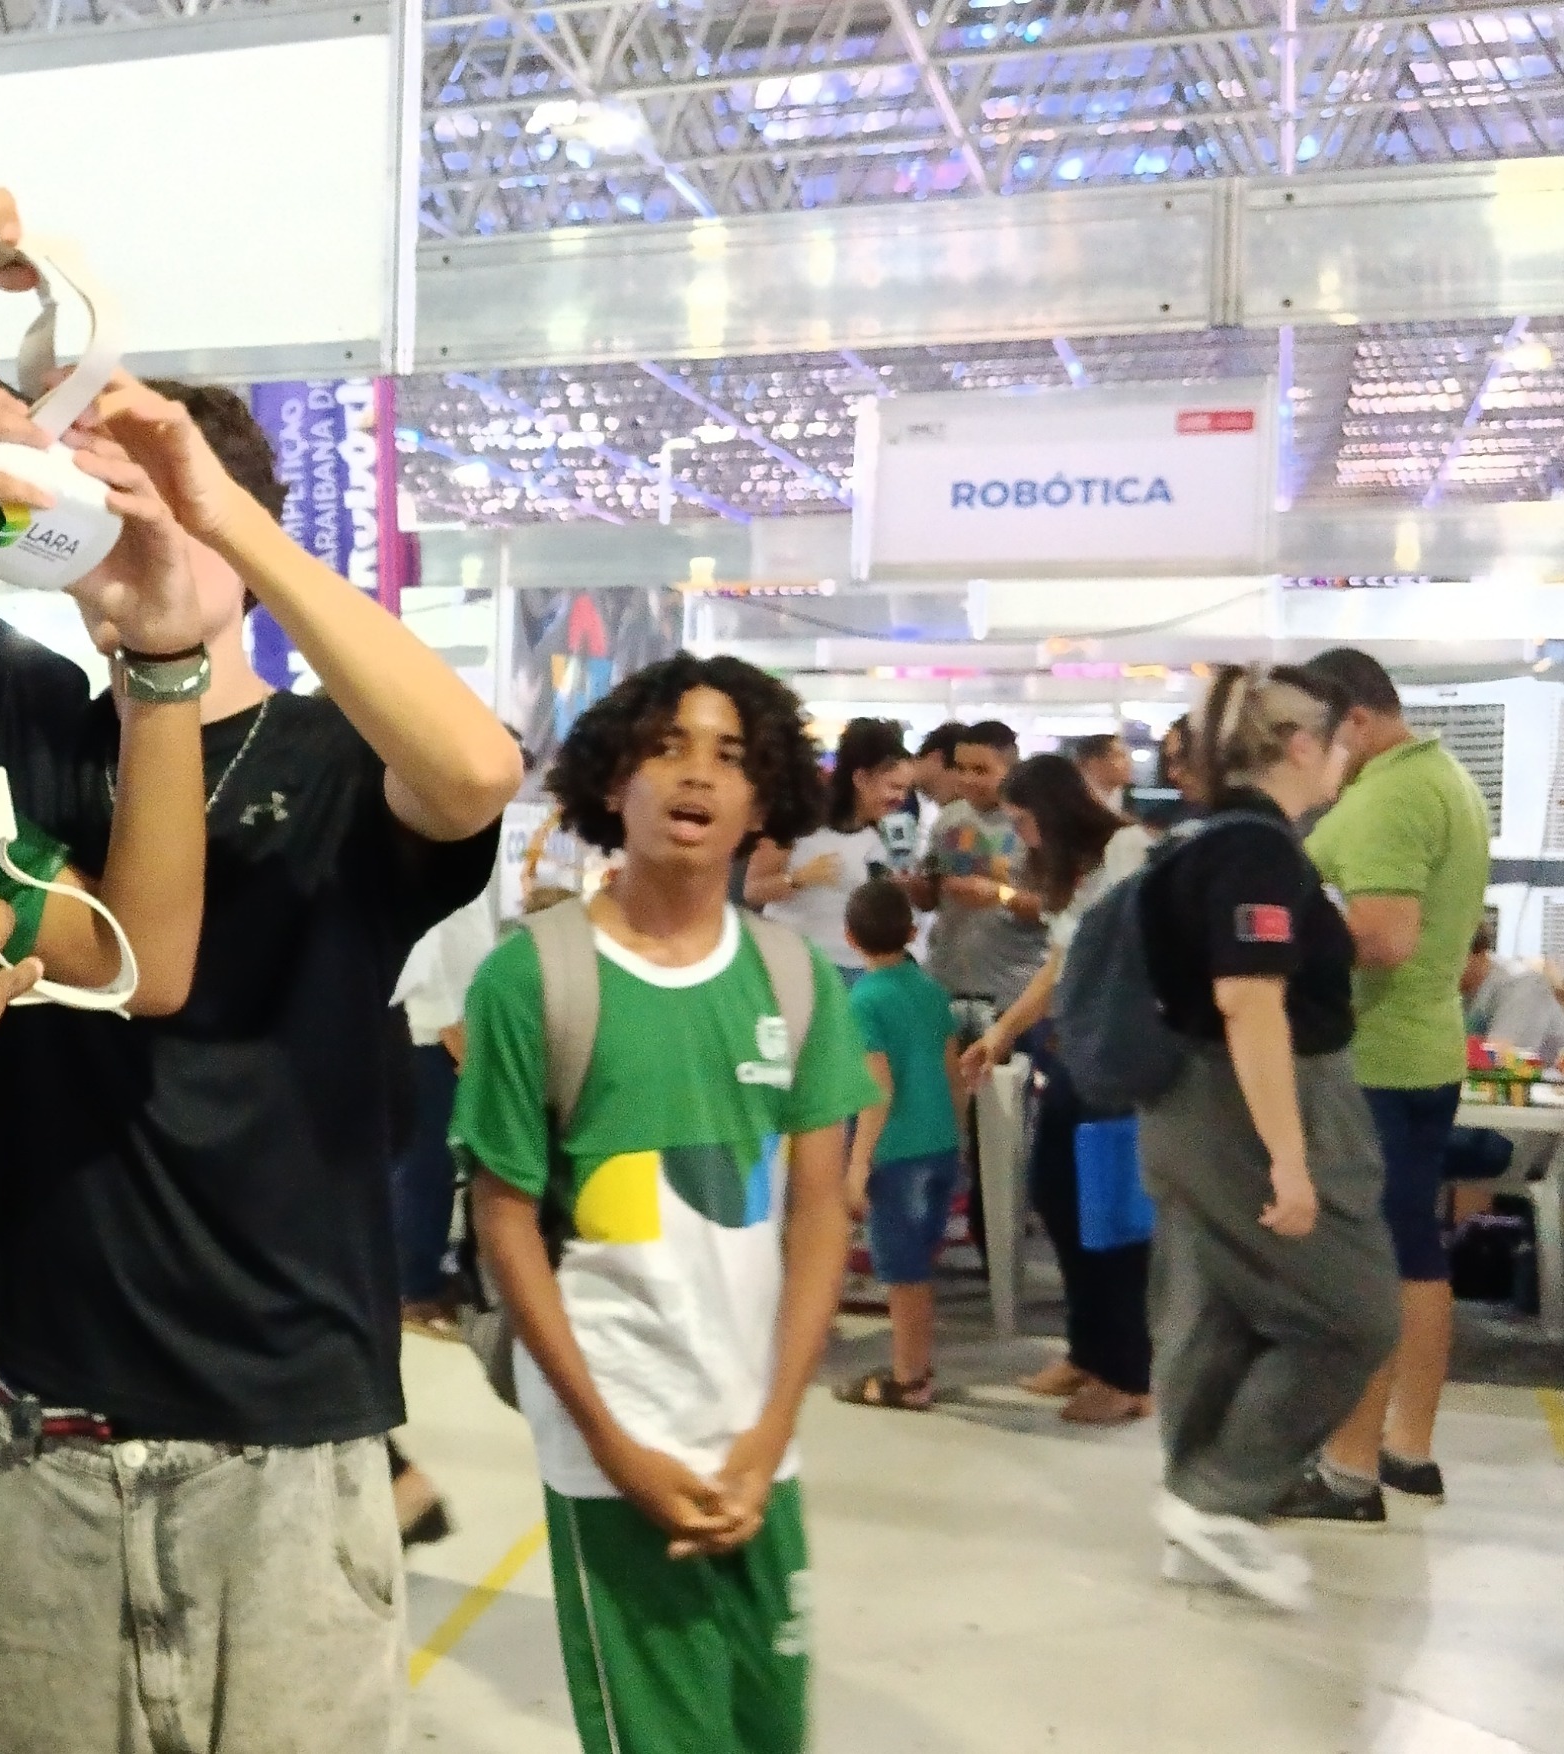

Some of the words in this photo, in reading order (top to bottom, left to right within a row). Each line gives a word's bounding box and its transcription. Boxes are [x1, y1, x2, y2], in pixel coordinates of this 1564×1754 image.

[308, 417, 338, 571] ARAIBANA
[950, 472, 1174, 509] ROBÓTICA
[26, 523, 80, 556] LARA
